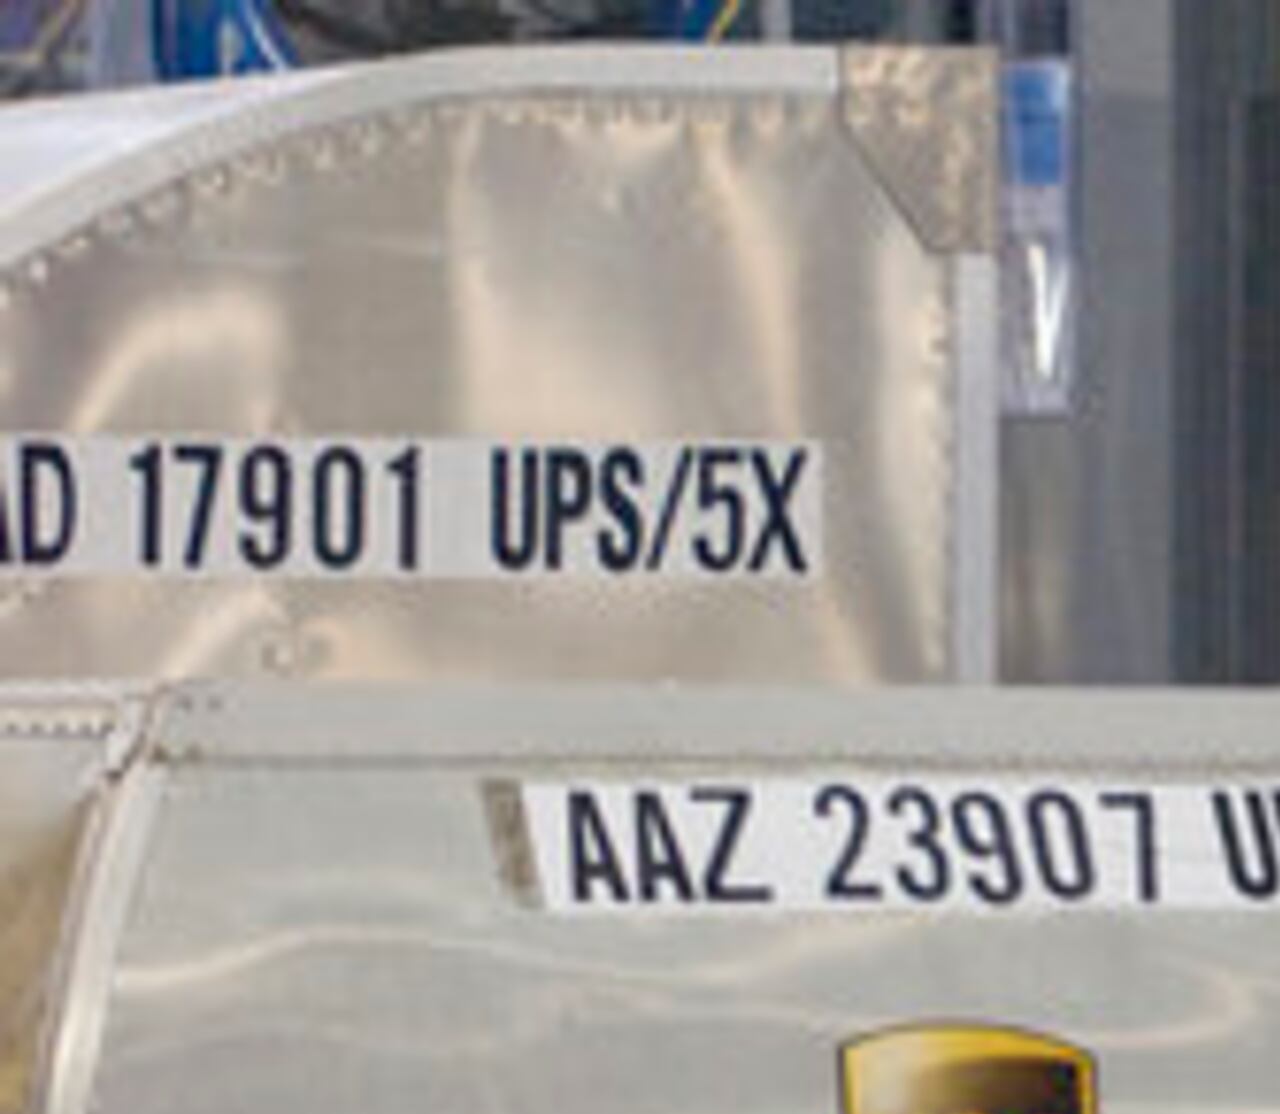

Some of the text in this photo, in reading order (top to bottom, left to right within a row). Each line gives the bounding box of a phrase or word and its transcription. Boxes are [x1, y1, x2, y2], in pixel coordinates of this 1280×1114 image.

[0, 441, 808, 574] D 17901 UPS/5X
[567, 784, 770, 902] AAZ
[814, 784, 1158, 906] 23907
